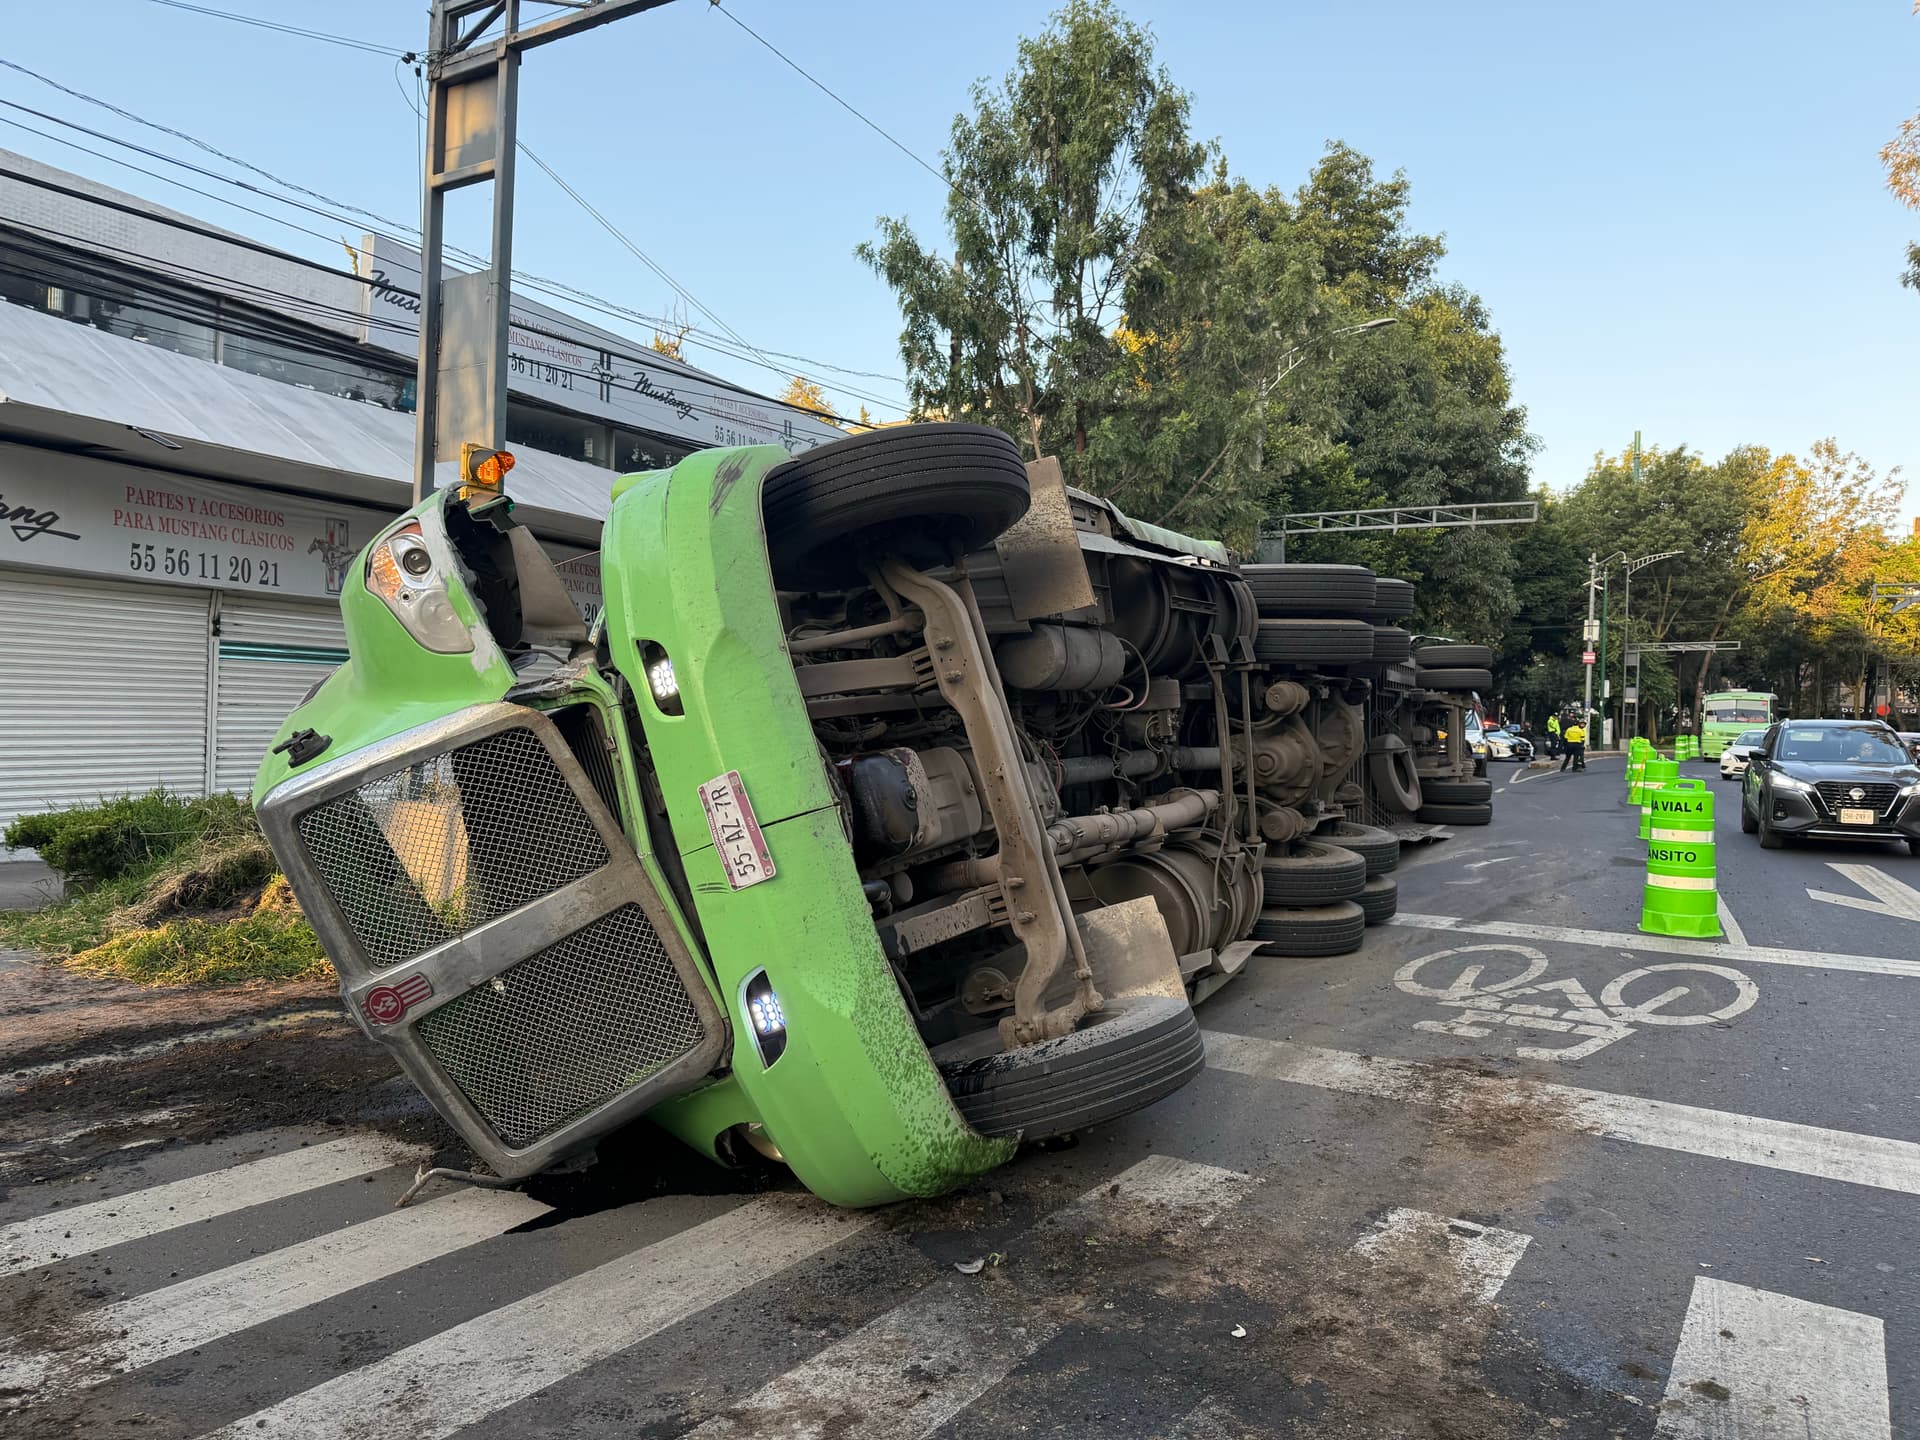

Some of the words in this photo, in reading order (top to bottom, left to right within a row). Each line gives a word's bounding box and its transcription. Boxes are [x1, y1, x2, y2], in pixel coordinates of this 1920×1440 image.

[511, 352, 525, 374] 56
[529, 359, 540, 379] 11
[545, 365, 558, 385] 20
[561, 371, 574, 391] 21
[634, 371, 699, 421] Mustang
[715, 425, 725, 443] 55
[726, 429, 736, 447] 56
[0, 493, 81, 542] ang
[125, 485, 184, 512] PARTES
[187, 498, 197, 514] Y
[200, 498, 285, 528] ACCESORIOS
[112, 508, 154, 532] PARA
[158, 516, 228, 543] MUSTANG
[231, 526, 295, 552] CLASICOS
[129, 542, 156, 573] 55
[164, 546, 190, 577] 56
[198, 552, 221, 580] 11
[228, 555, 252, 585] 20
[258, 560, 281, 587] 21
[1661, 801, 1692, 813] VIAL
[1695, 801, 1704, 813] 4
[710, 784, 756, 877] 55-AZ-7R
